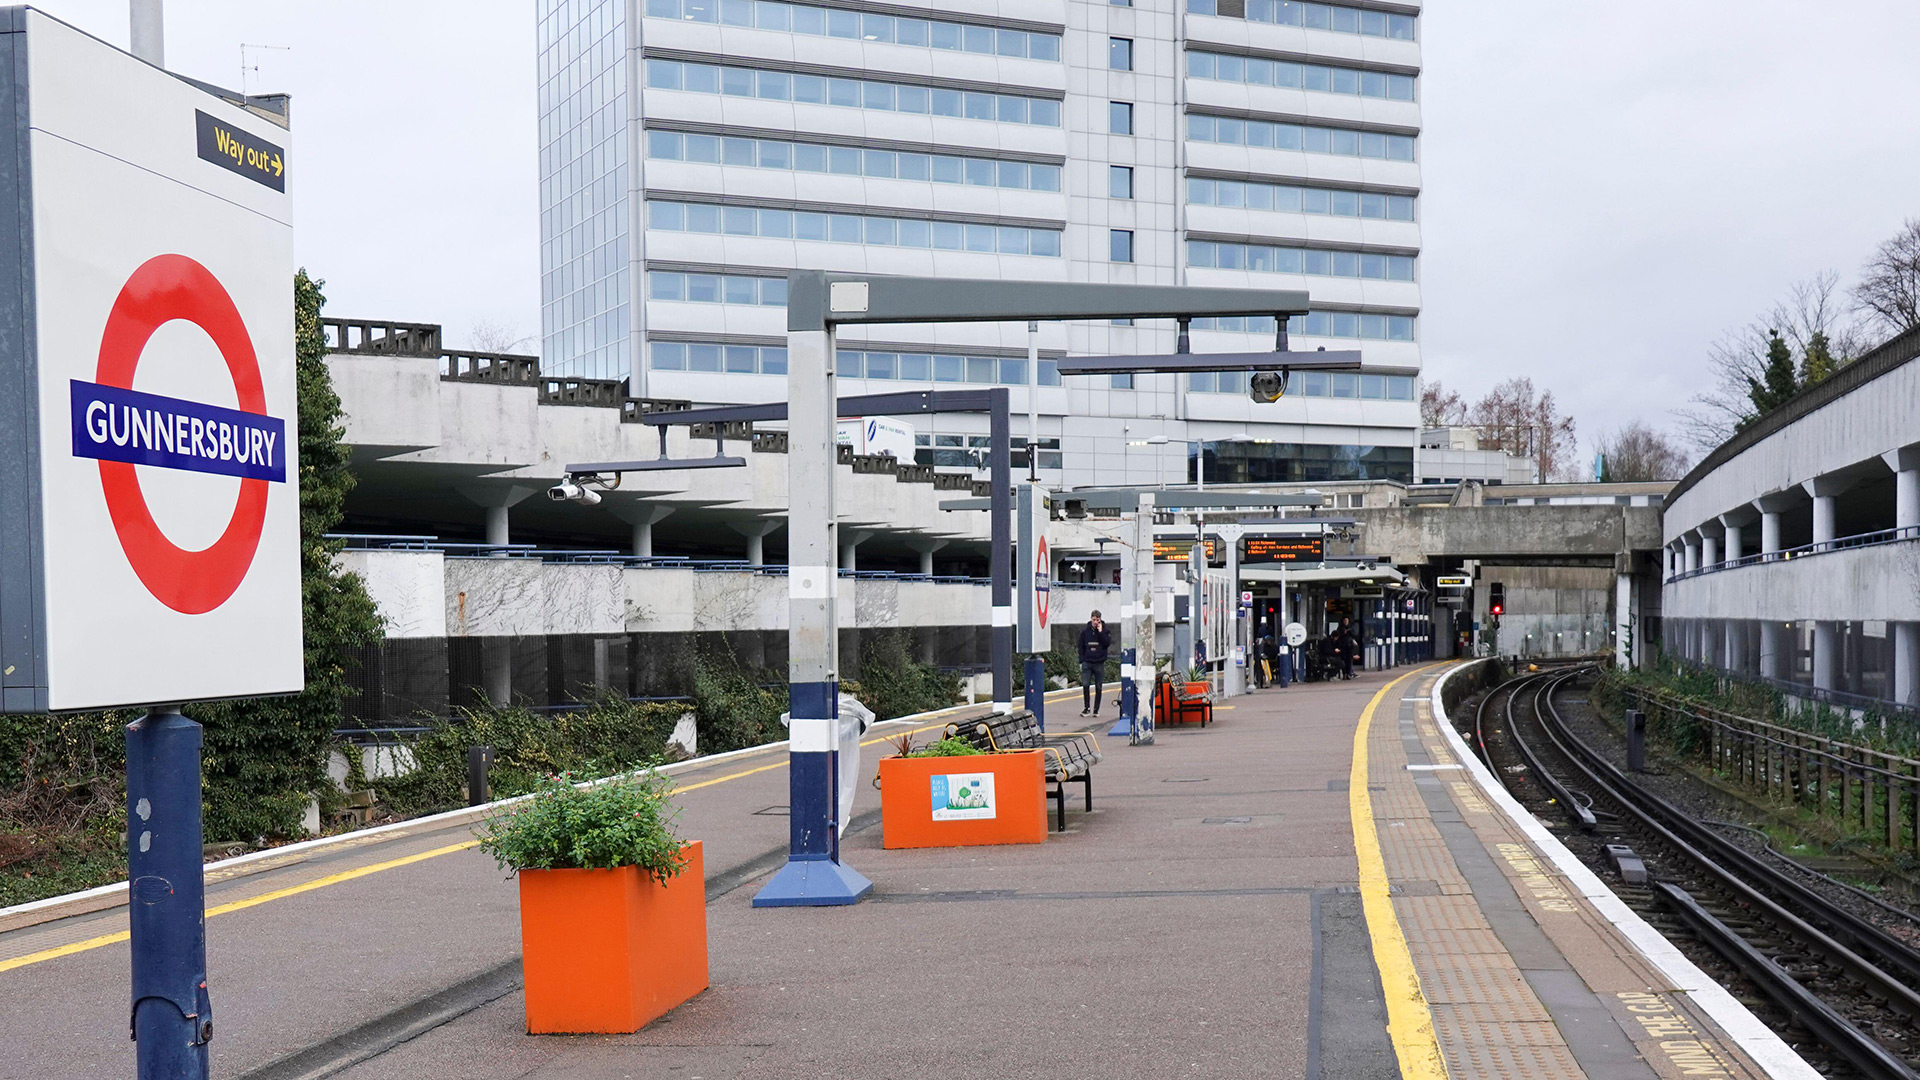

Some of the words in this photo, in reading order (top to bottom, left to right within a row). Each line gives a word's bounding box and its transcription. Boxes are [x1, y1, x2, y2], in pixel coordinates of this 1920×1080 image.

[214, 126, 245, 166] Way
[247, 147, 270, 173] out
[85, 399, 277, 468] GUNNERSBURY
[1616, 992, 1674, 1013] GAP
[1635, 1014, 1698, 1037] THE
[1659, 1040, 1735, 1075] MIND
